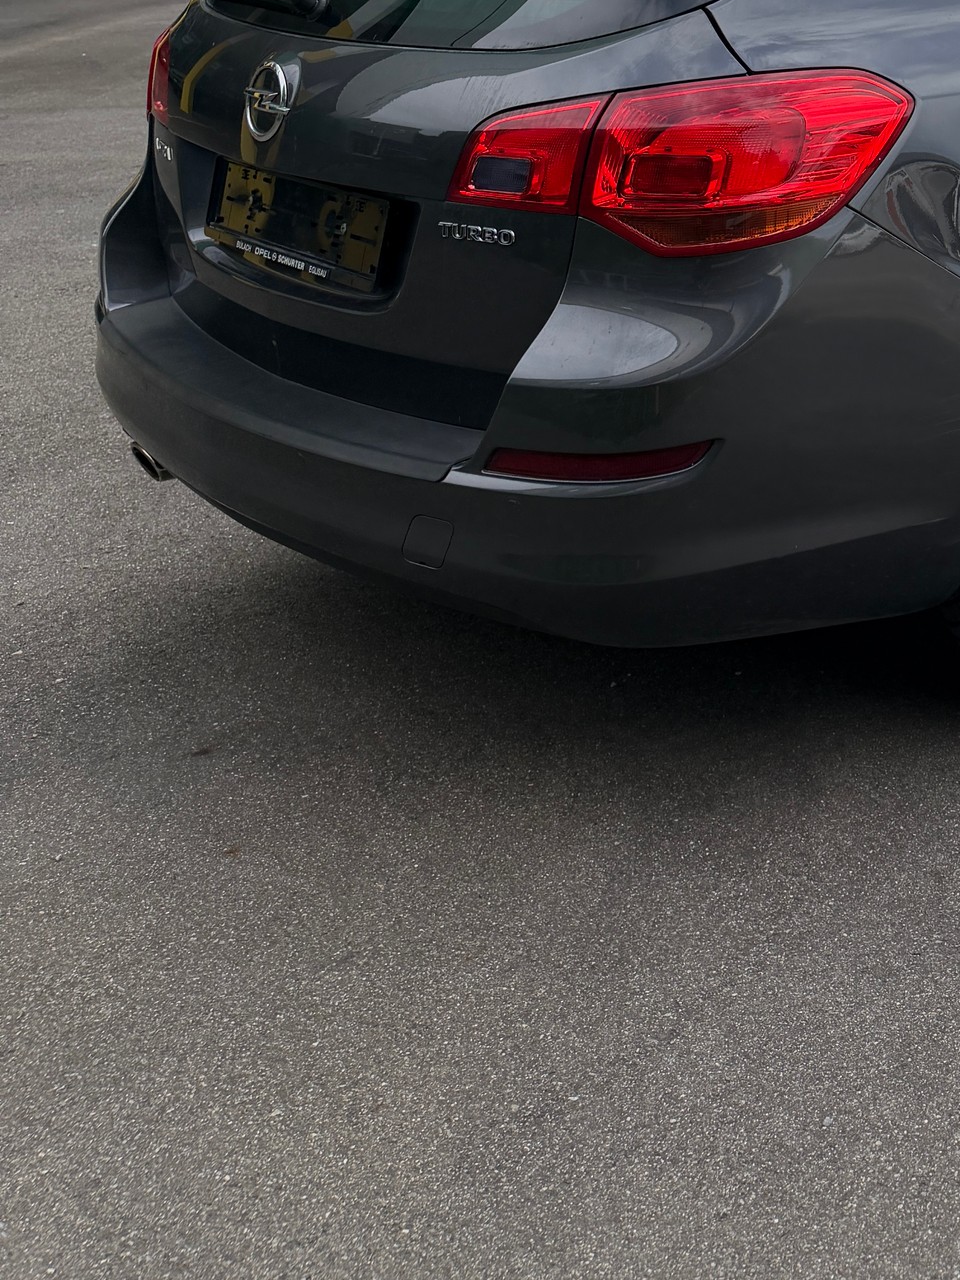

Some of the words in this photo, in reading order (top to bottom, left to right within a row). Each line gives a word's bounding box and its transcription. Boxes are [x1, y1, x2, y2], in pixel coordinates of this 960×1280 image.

[437, 221, 516, 246] TURBO
[254, 246, 272, 260] OPEL
[277, 254, 305, 271] SCHURTER
[308, 265, 327, 278] EGLISAU
